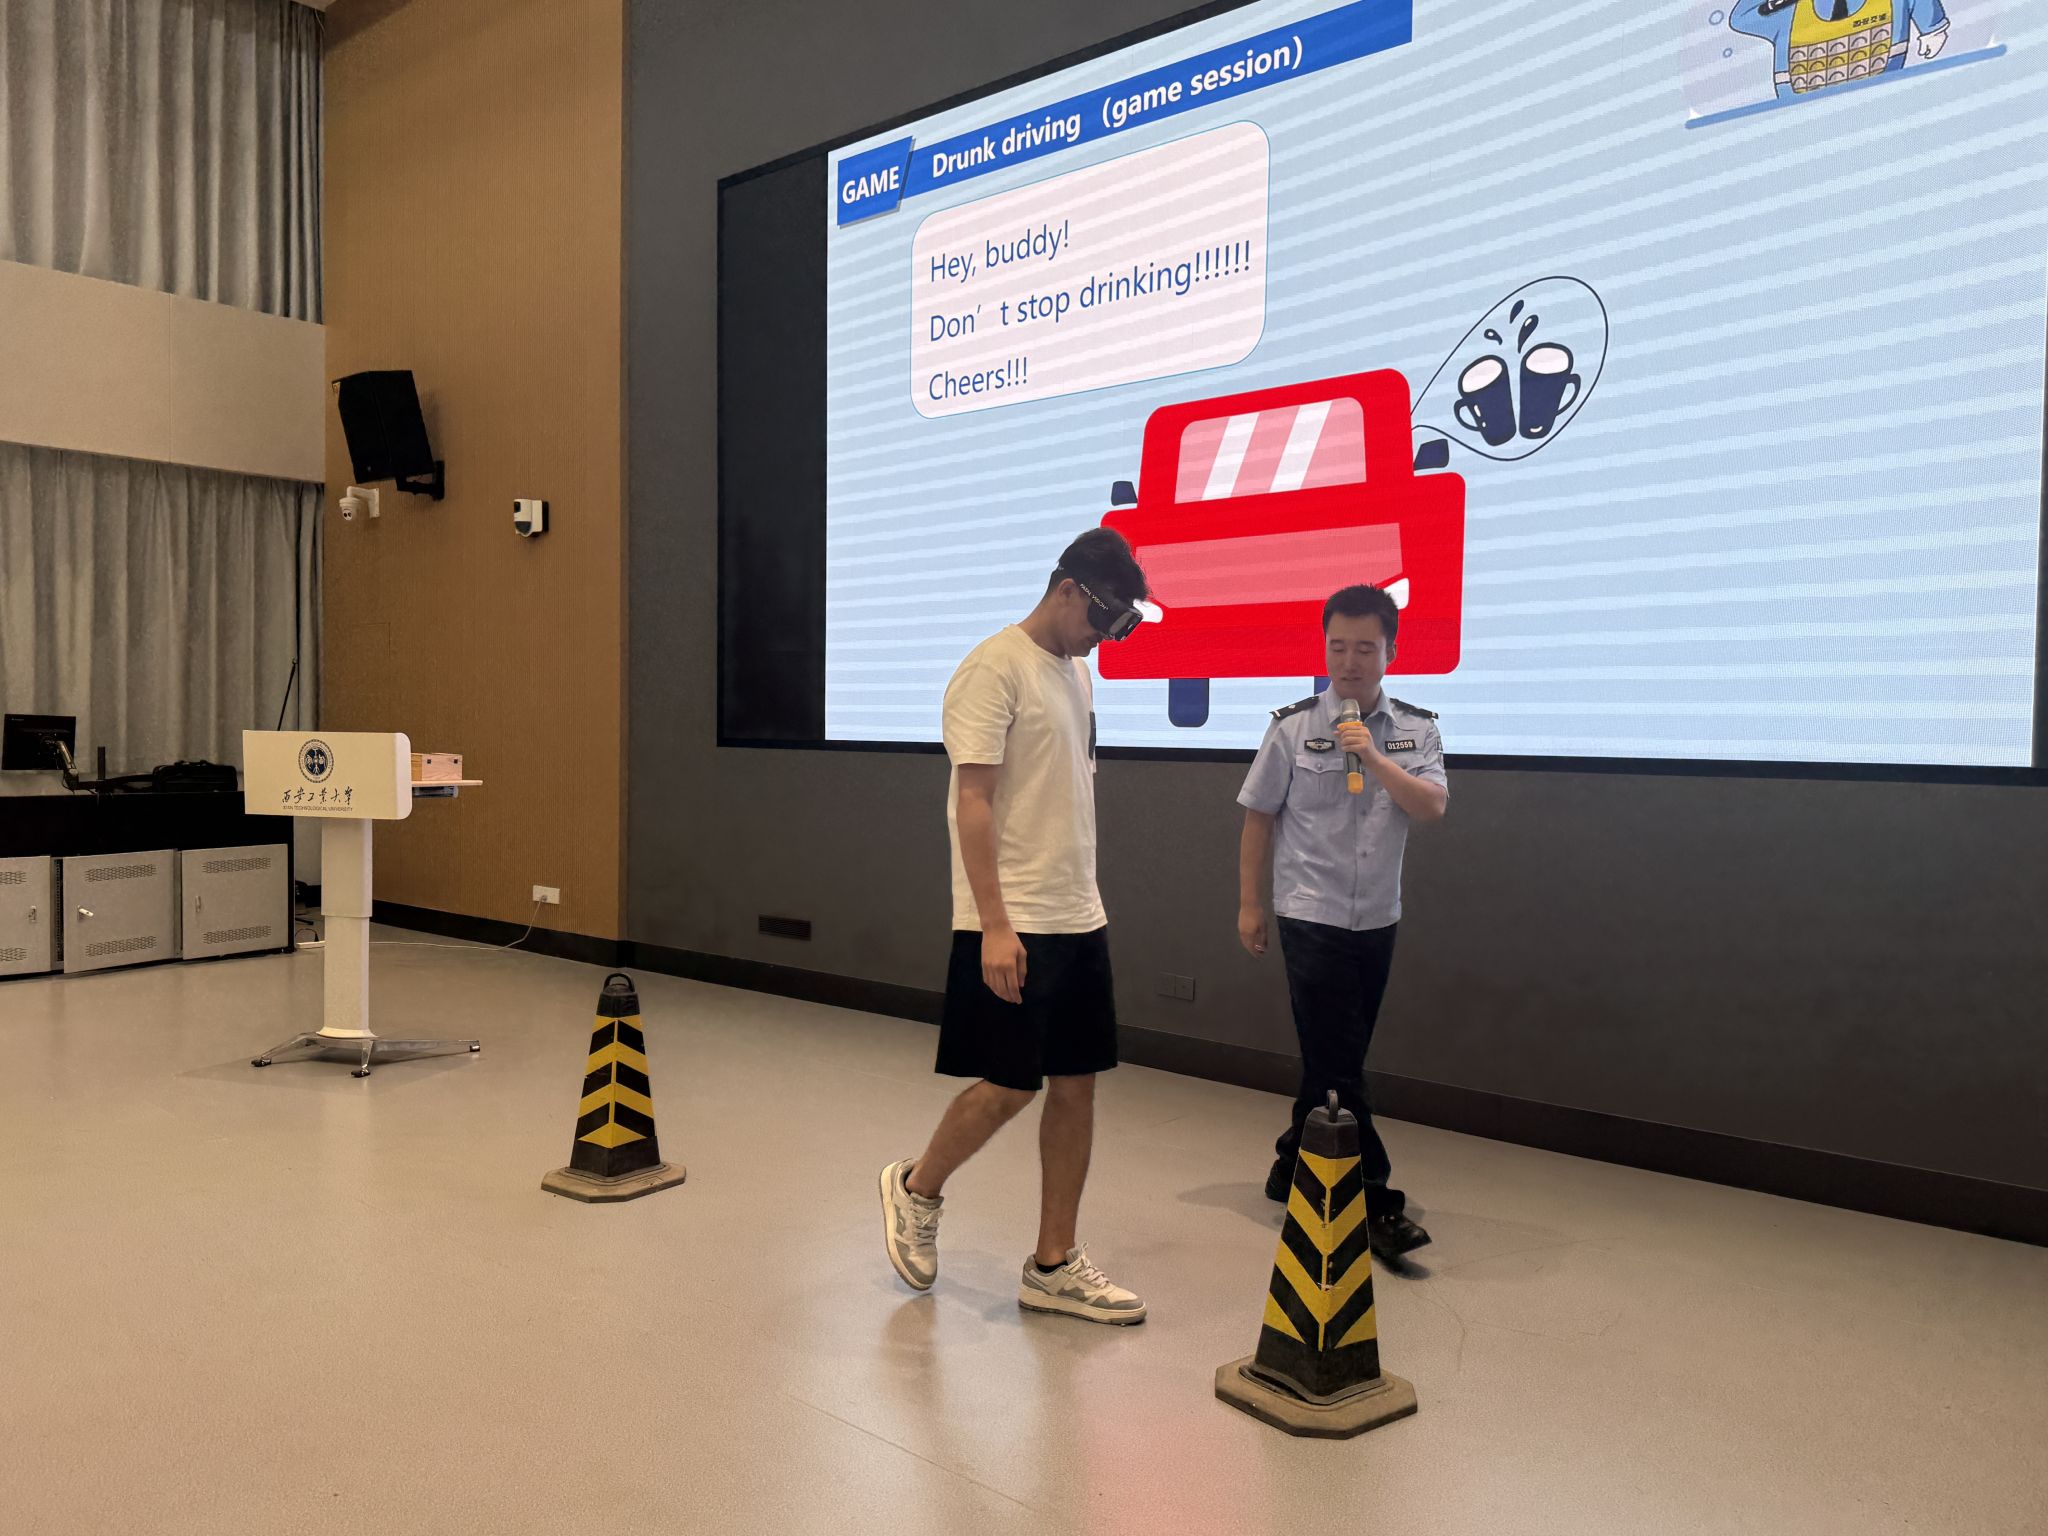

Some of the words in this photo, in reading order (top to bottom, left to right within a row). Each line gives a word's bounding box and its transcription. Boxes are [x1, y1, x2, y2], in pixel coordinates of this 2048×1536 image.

[931, 138, 997, 179] Drunk
[1001, 111, 1081, 156] driving
[1101, 80, 1183, 129] (game
[1190, 36, 1303, 97] session)
[842, 166, 900, 204] GAME
[931, 252, 977, 283] Hey,
[986, 220, 1069, 269] buddy!
[1018, 291, 1070, 323] stop
[1080, 240, 1250, 308] drinking!!!!!!
[929, 357, 1028, 401] Cheers!!!
